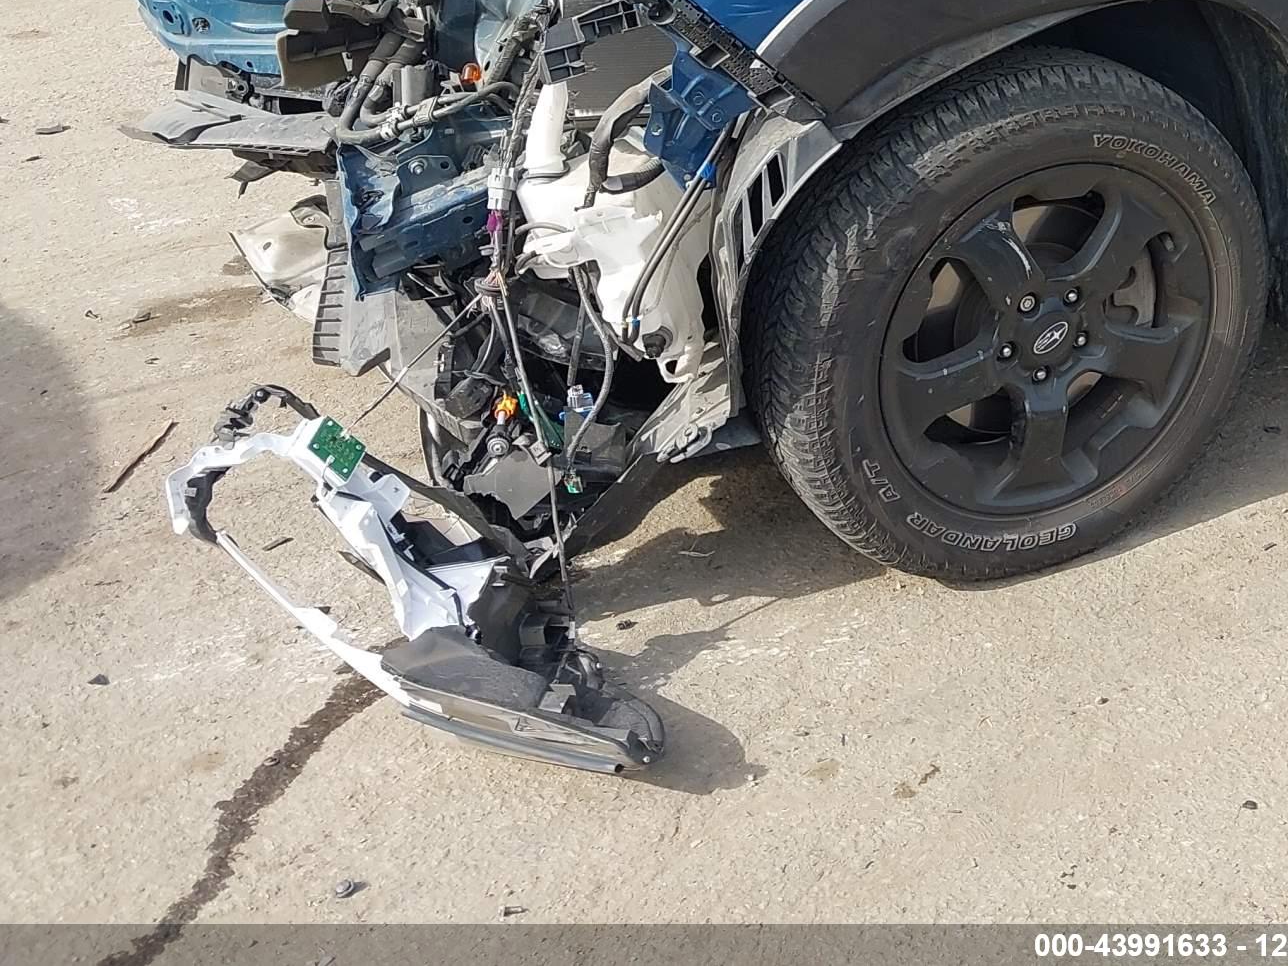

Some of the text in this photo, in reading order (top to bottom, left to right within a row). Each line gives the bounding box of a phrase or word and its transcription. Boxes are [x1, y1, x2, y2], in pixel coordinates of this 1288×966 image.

[1093, 134, 1217, 206] YOKOHAMA
[862, 458, 1078, 551] GEOLANDAR A/T
